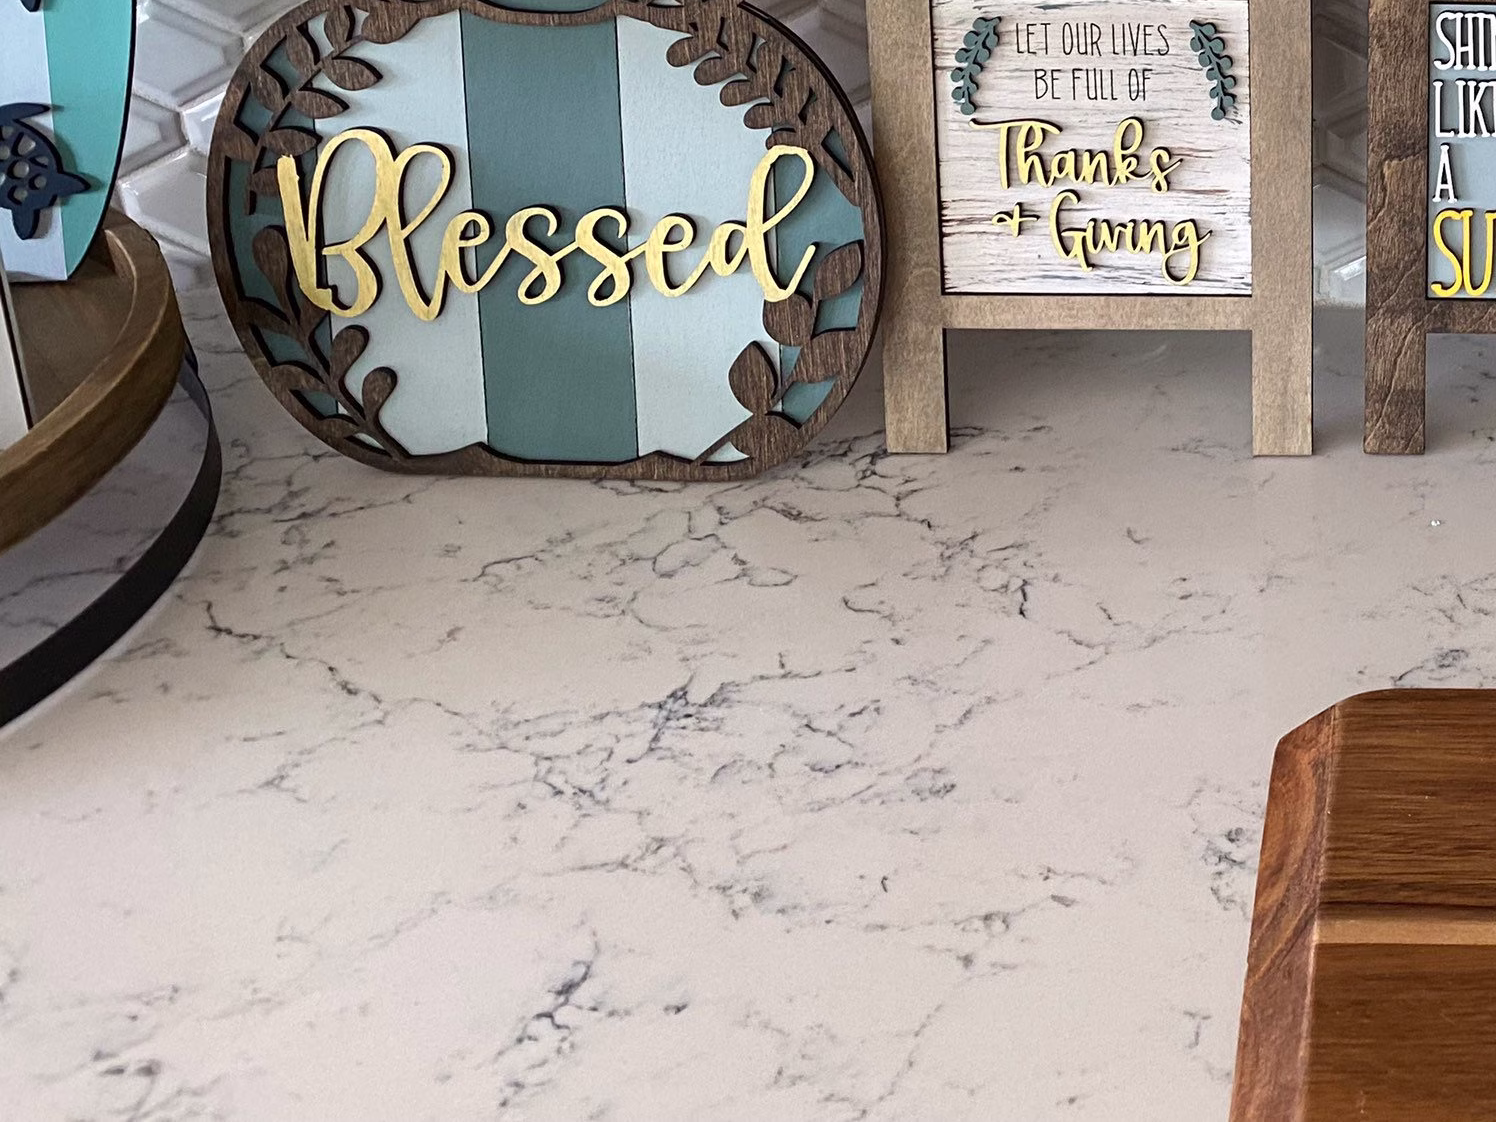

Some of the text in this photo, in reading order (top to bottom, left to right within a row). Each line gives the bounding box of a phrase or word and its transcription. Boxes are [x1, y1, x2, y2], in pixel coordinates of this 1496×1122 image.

[1015, 22, 1171, 57] LET OUR LIVES
[1034, 68, 1153, 102] BE FULL OF
[969, 116, 1183, 193] Thanks
[1432, 143, 1458, 203] A
[277, 127, 816, 321] Blessed
[1048, 189, 1213, 286] Giving
